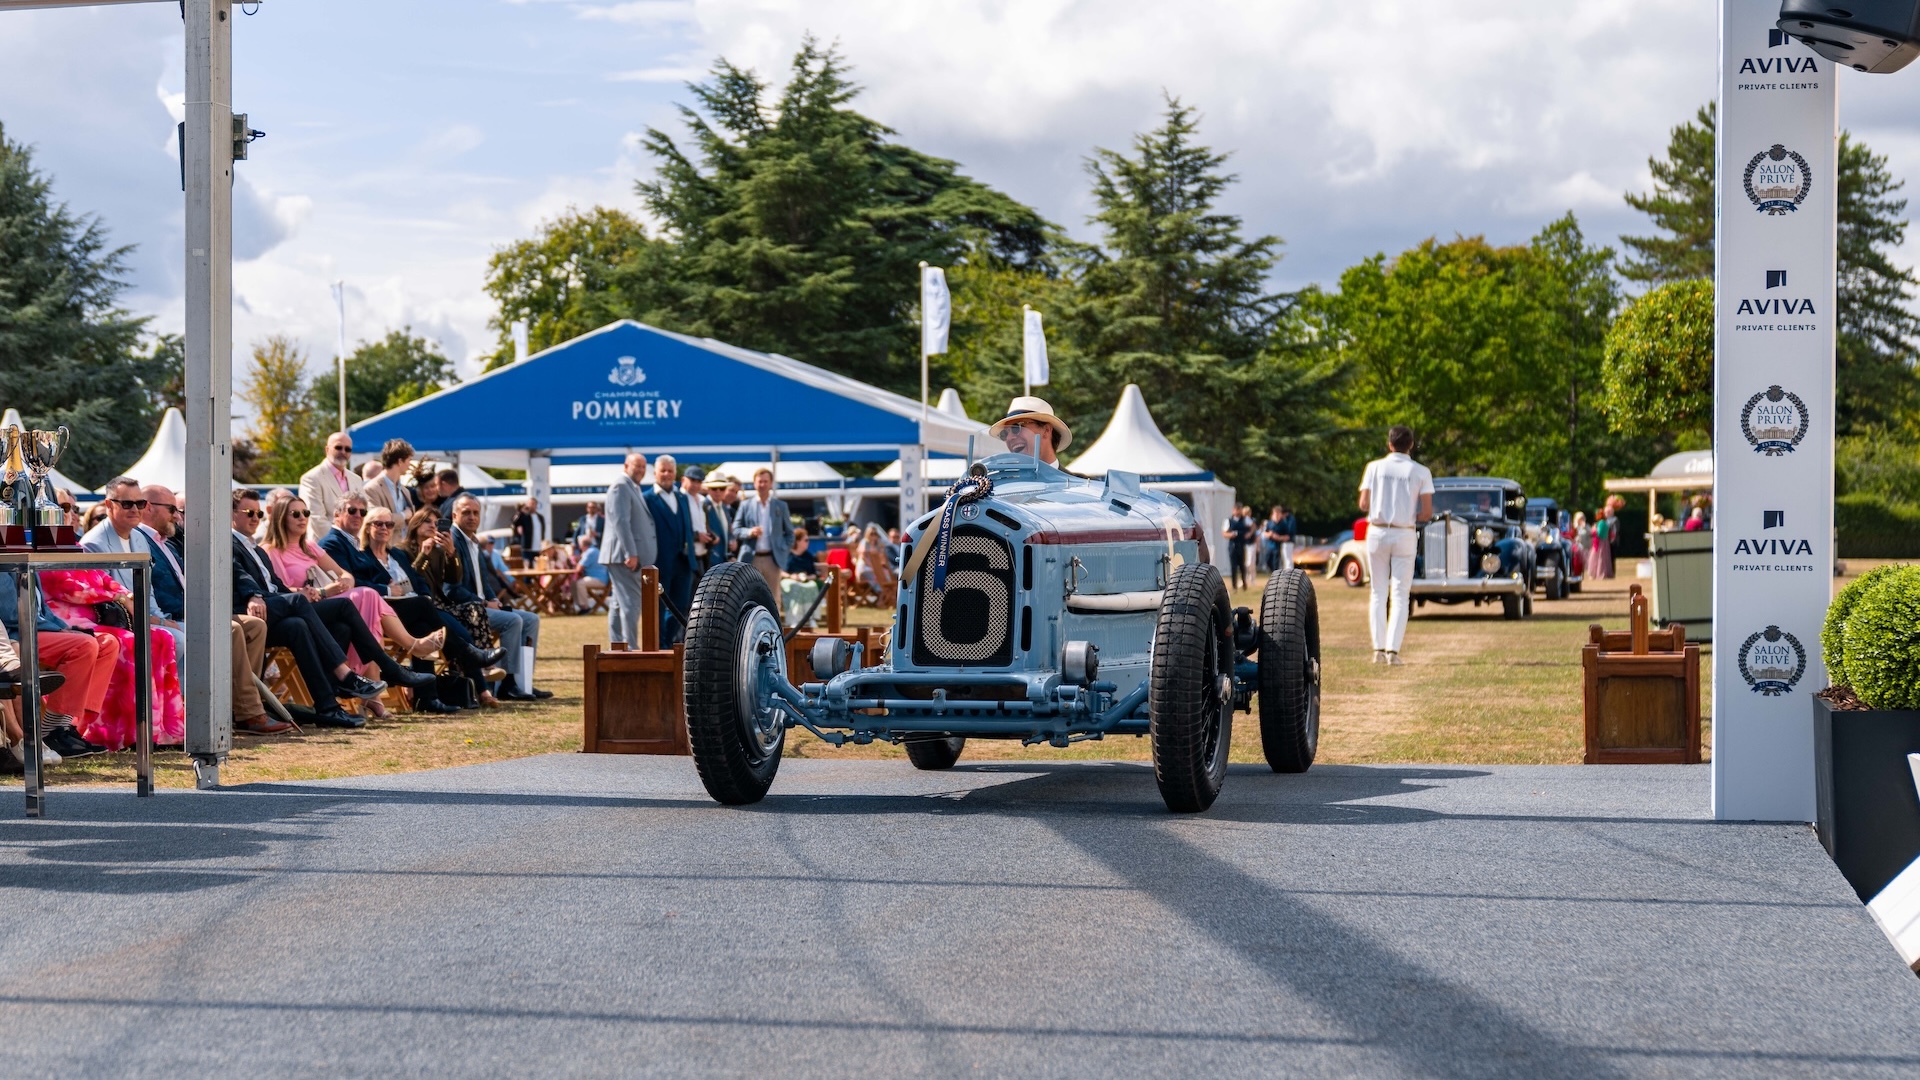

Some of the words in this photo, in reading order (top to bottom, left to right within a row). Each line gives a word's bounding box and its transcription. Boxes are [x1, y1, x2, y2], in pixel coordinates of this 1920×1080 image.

[1738, 57, 1819, 74] AVIVA
[1738, 83, 1777, 91] PRIVATE
[1759, 164, 1796, 174] SALON
[1759, 173, 1796, 184] PRIVÉ
[1736, 298, 1817, 315] AVIVA
[594, 391, 661, 399] CHAMPAGNE
[572, 399, 682, 420] POMMERY
[1757, 405, 1793, 415] SALON
[1757, 414, 1793, 425] PRIVÉ
[942, 501, 954, 529] CLASS
[937, 530, 949, 567] WINNER
[1733, 538, 1814, 556] AVIVA
[1774, 564, 1814, 572] CLIENTS
[921, 535, 1010, 661] 6
[1754, 645, 1790, 655] SALON
[1754, 654, 1790, 665] PRIVÉ
